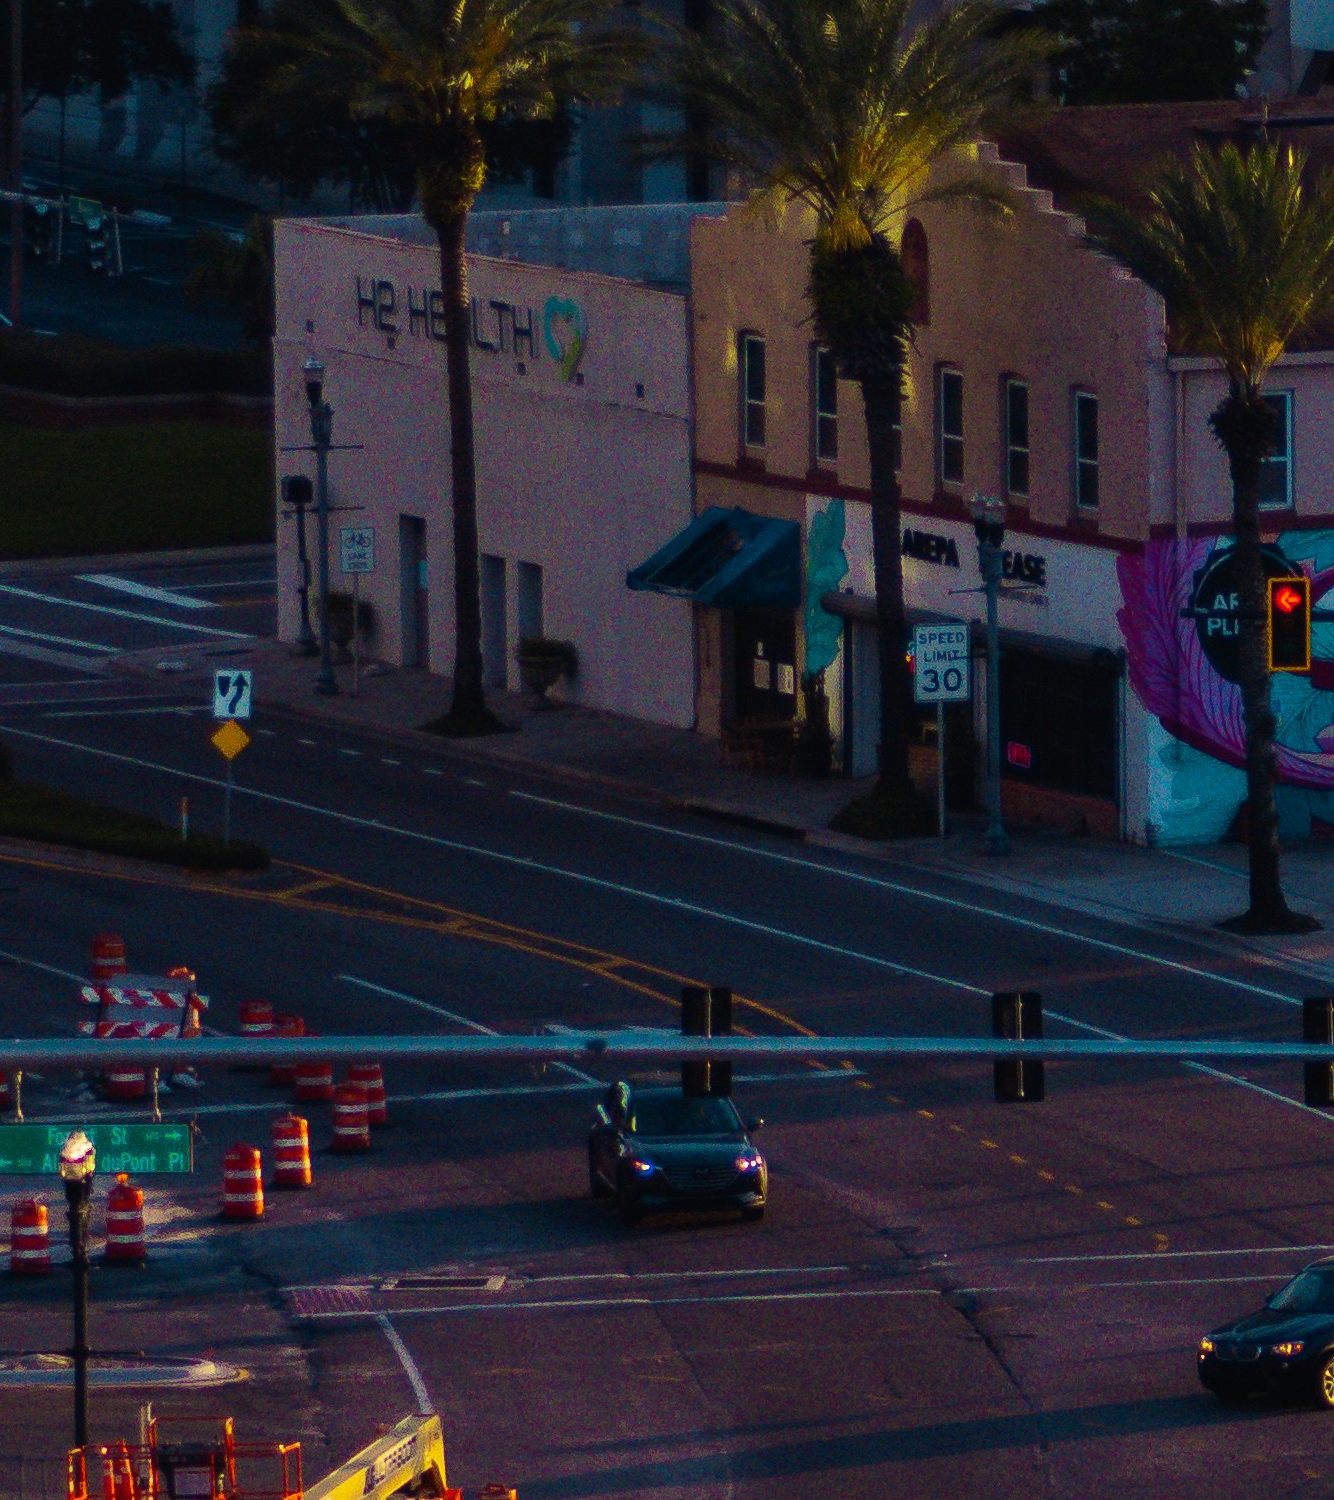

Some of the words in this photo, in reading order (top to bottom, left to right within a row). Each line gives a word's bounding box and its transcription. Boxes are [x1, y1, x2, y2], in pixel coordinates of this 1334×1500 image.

[407, 283, 534, 359] HELTH
[918, 632, 965, 644] SPEED
[923, 650, 961, 663] LIMIT
[922, 667, 963, 693] 30
